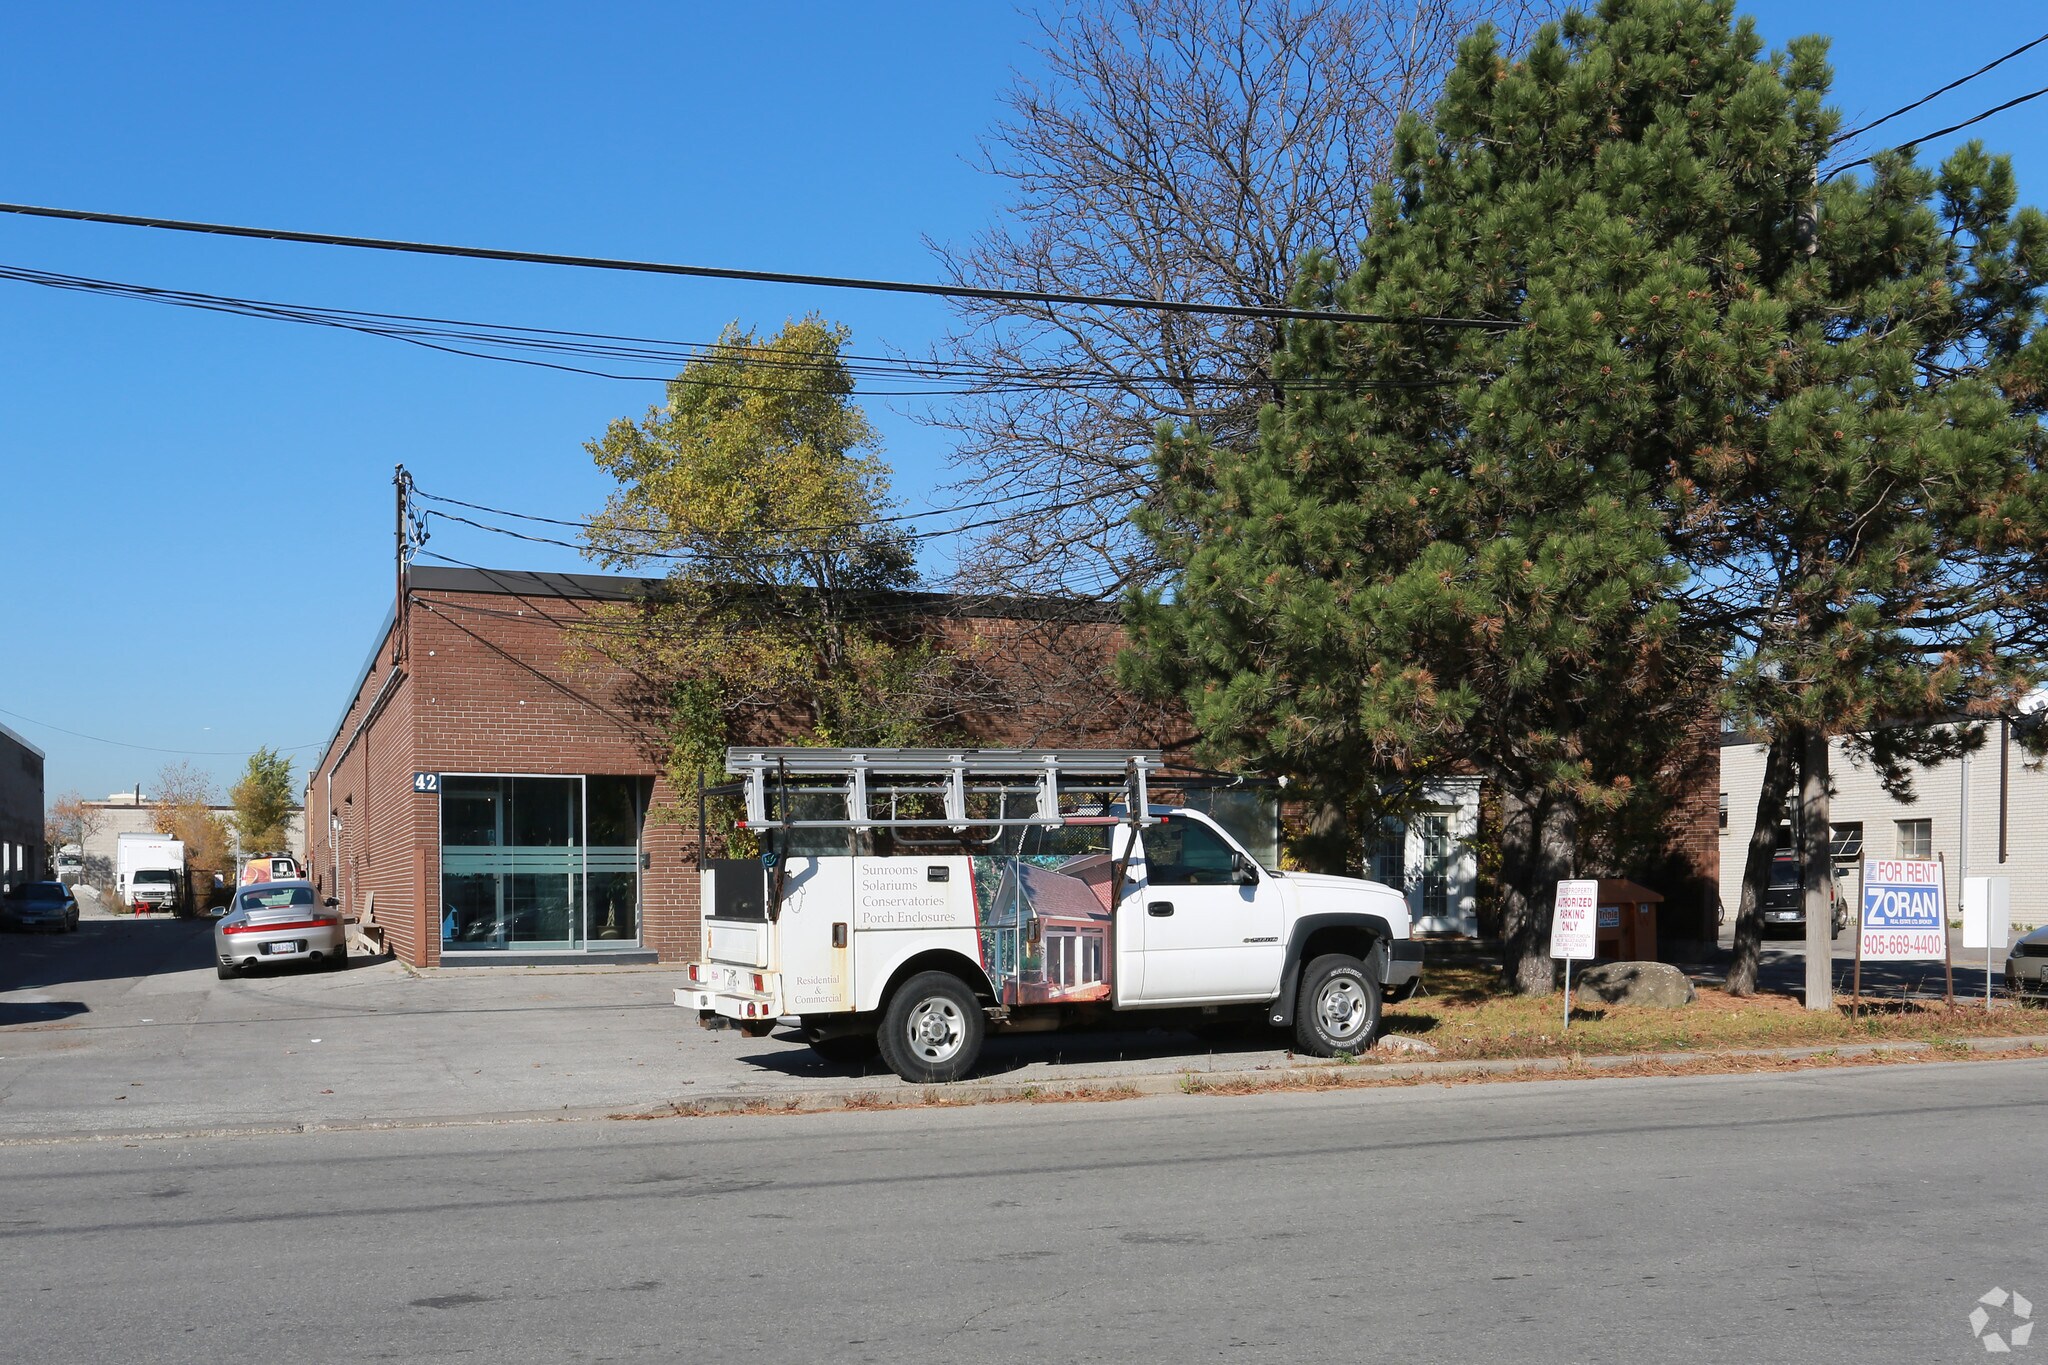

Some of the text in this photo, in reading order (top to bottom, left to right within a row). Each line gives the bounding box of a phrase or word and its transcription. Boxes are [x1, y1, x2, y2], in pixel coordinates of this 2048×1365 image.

[415, 774, 437, 790] 42
[862, 864, 918, 875] Sunrooms
[1878, 861, 1938, 882] FOR RENT
[862, 879, 918, 891] Solariums
[862, 895, 945, 907] Conservatories
[1558, 897, 1593, 908] AUTHORIZED
[1867, 888, 1937, 925] ZORAN
[863, 911, 956, 923] Porch Enclosures
[1559, 909, 1585, 919] PARKING
[1562, 921, 1578, 931] ONLY
[1864, 934, 1941, 955] 905-669-4400
[796, 974, 840, 985] Residential
[814, 986, 822, 995] &
[794, 993, 842, 1004] Commercial
